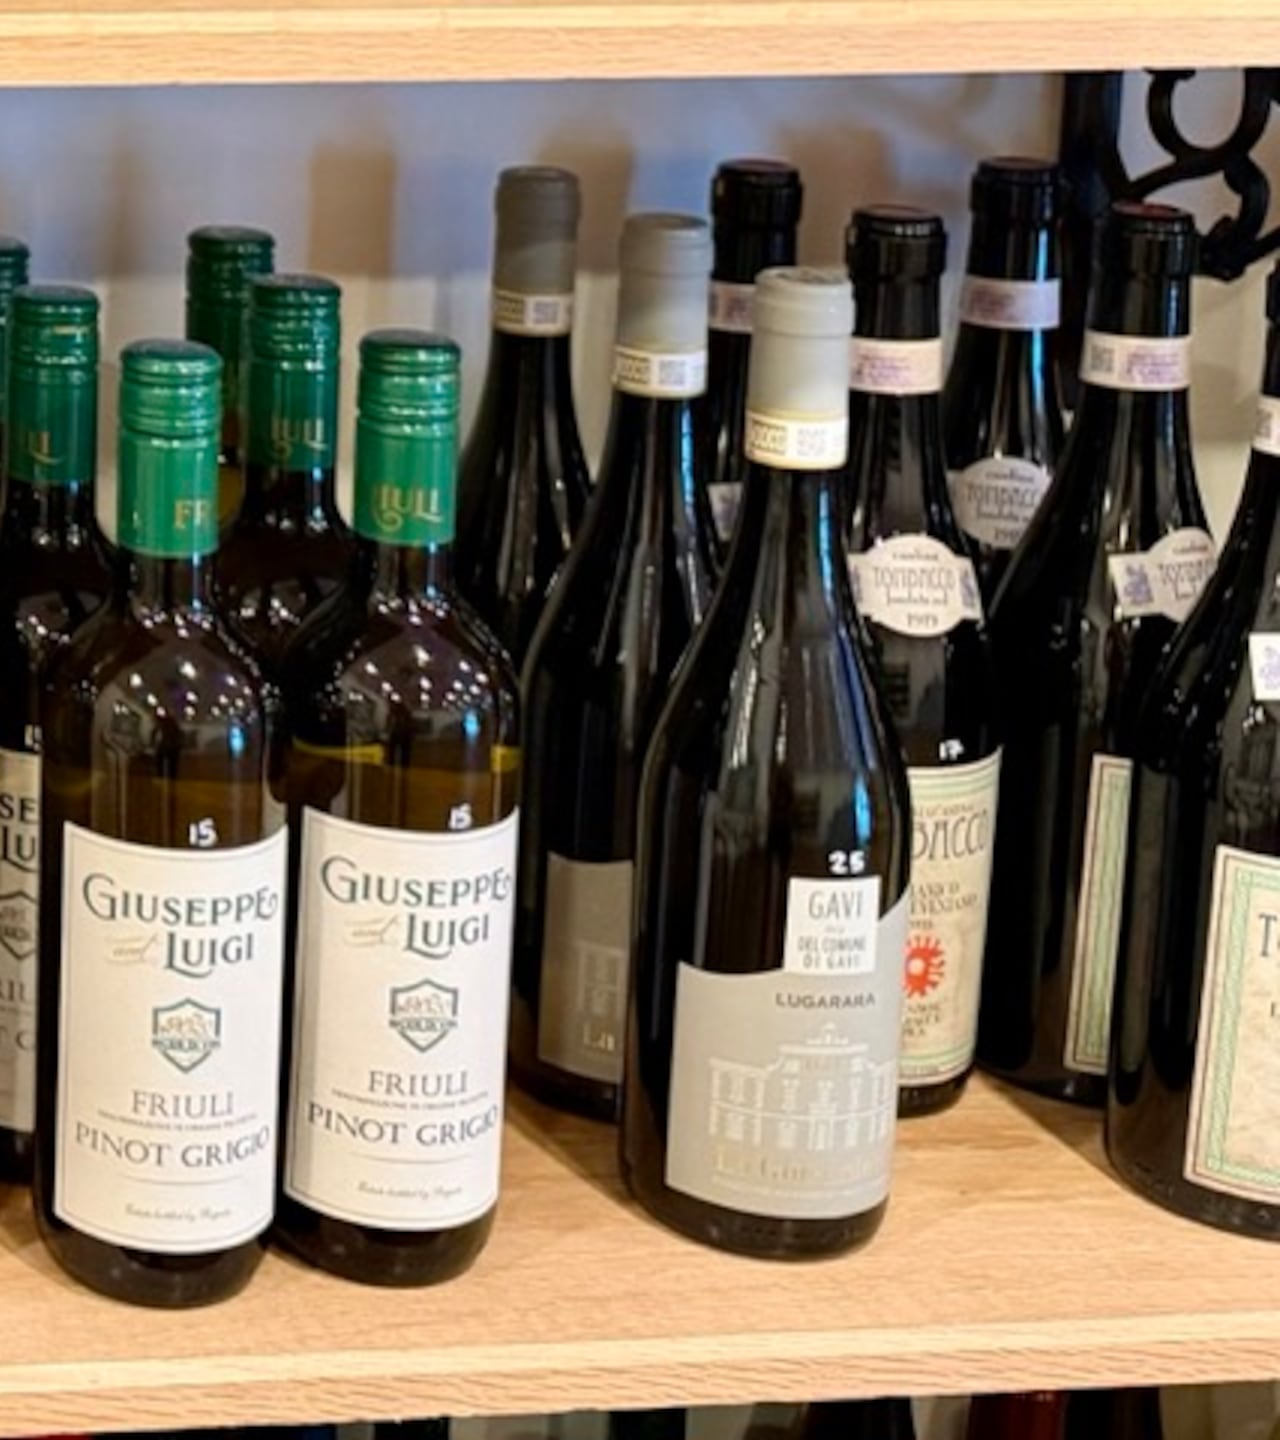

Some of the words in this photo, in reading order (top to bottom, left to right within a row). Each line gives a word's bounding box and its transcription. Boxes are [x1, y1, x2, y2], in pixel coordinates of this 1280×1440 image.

[189, 818, 217, 846] 15
[828, 850, 865, 875] 25
[82, 872, 278, 928] GIUSEPPE
[321, 854, 510, 909] GIUSEPPE
[808, 890, 864, 920] GAVI
[164, 931, 254, 979] LUIGI
[404, 913, 489, 960] LUIGI
[775, 991, 877, 1009] LUGARARA
[368, 1069, 468, 1097] FRIULI
[132, 1089, 233, 1118] FRIULI
[308, 1101, 407, 1145] PINOT
[416, 1103, 498, 1146] GRIGIO
[76, 1121, 174, 1167] PINOT
[181, 1124, 270, 1168] GRIGIO
